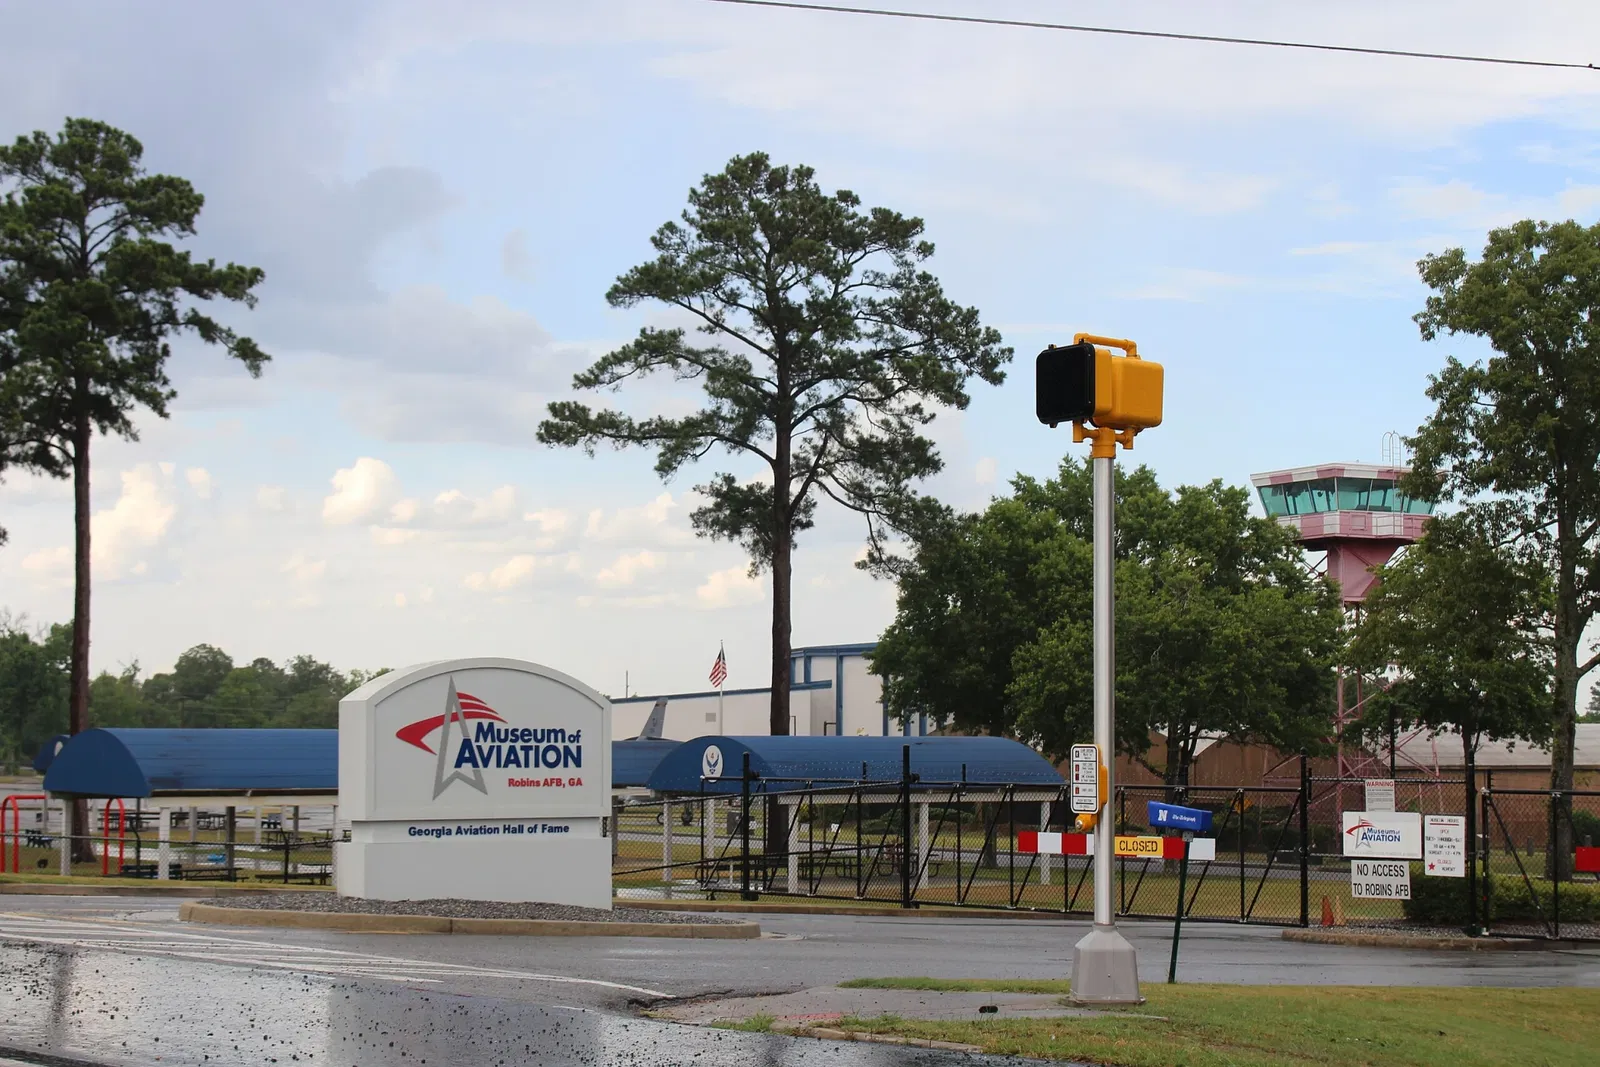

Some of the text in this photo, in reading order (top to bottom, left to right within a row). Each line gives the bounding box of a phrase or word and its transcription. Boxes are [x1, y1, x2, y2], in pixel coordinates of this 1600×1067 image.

[475, 722, 582, 743] Museum of
[454, 738, 582, 768] AVIATION
[508, 777, 583, 789] Robins AFB, GA
[408, 823, 570, 839] Georgia Aviation Hall of Fame
[1361, 832, 1401, 842] AVIATION
[1119, 840, 1158, 853] CLOSED
[1356, 863, 1405, 877] NO ACCESS
[1353, 883, 1409, 896] TO ROBINS AFB
